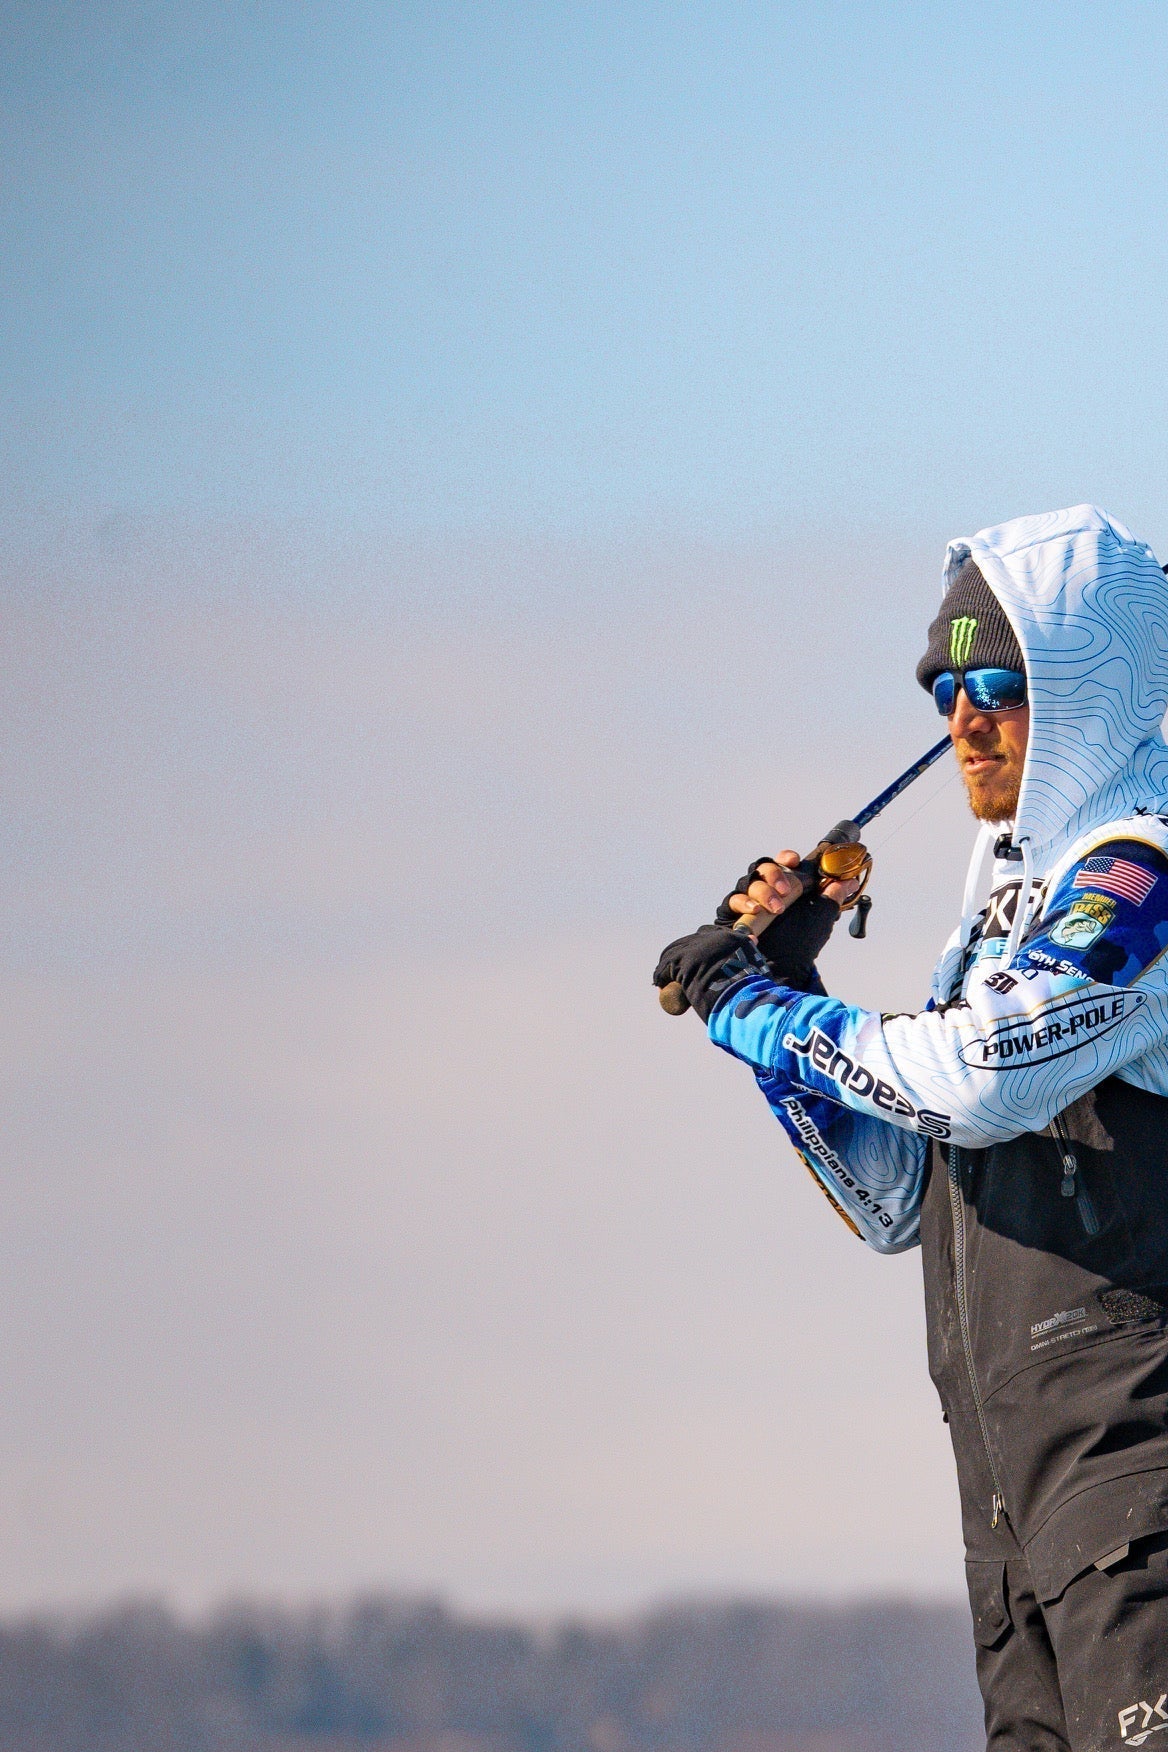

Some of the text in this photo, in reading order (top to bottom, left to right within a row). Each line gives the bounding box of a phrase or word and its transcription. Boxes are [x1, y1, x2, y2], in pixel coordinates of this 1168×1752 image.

[982, 998, 1125, 1061] POWER-POLE
[783, 1098, 856, 1189] Philippians
[855, 1188, 894, 1228] 4:13
